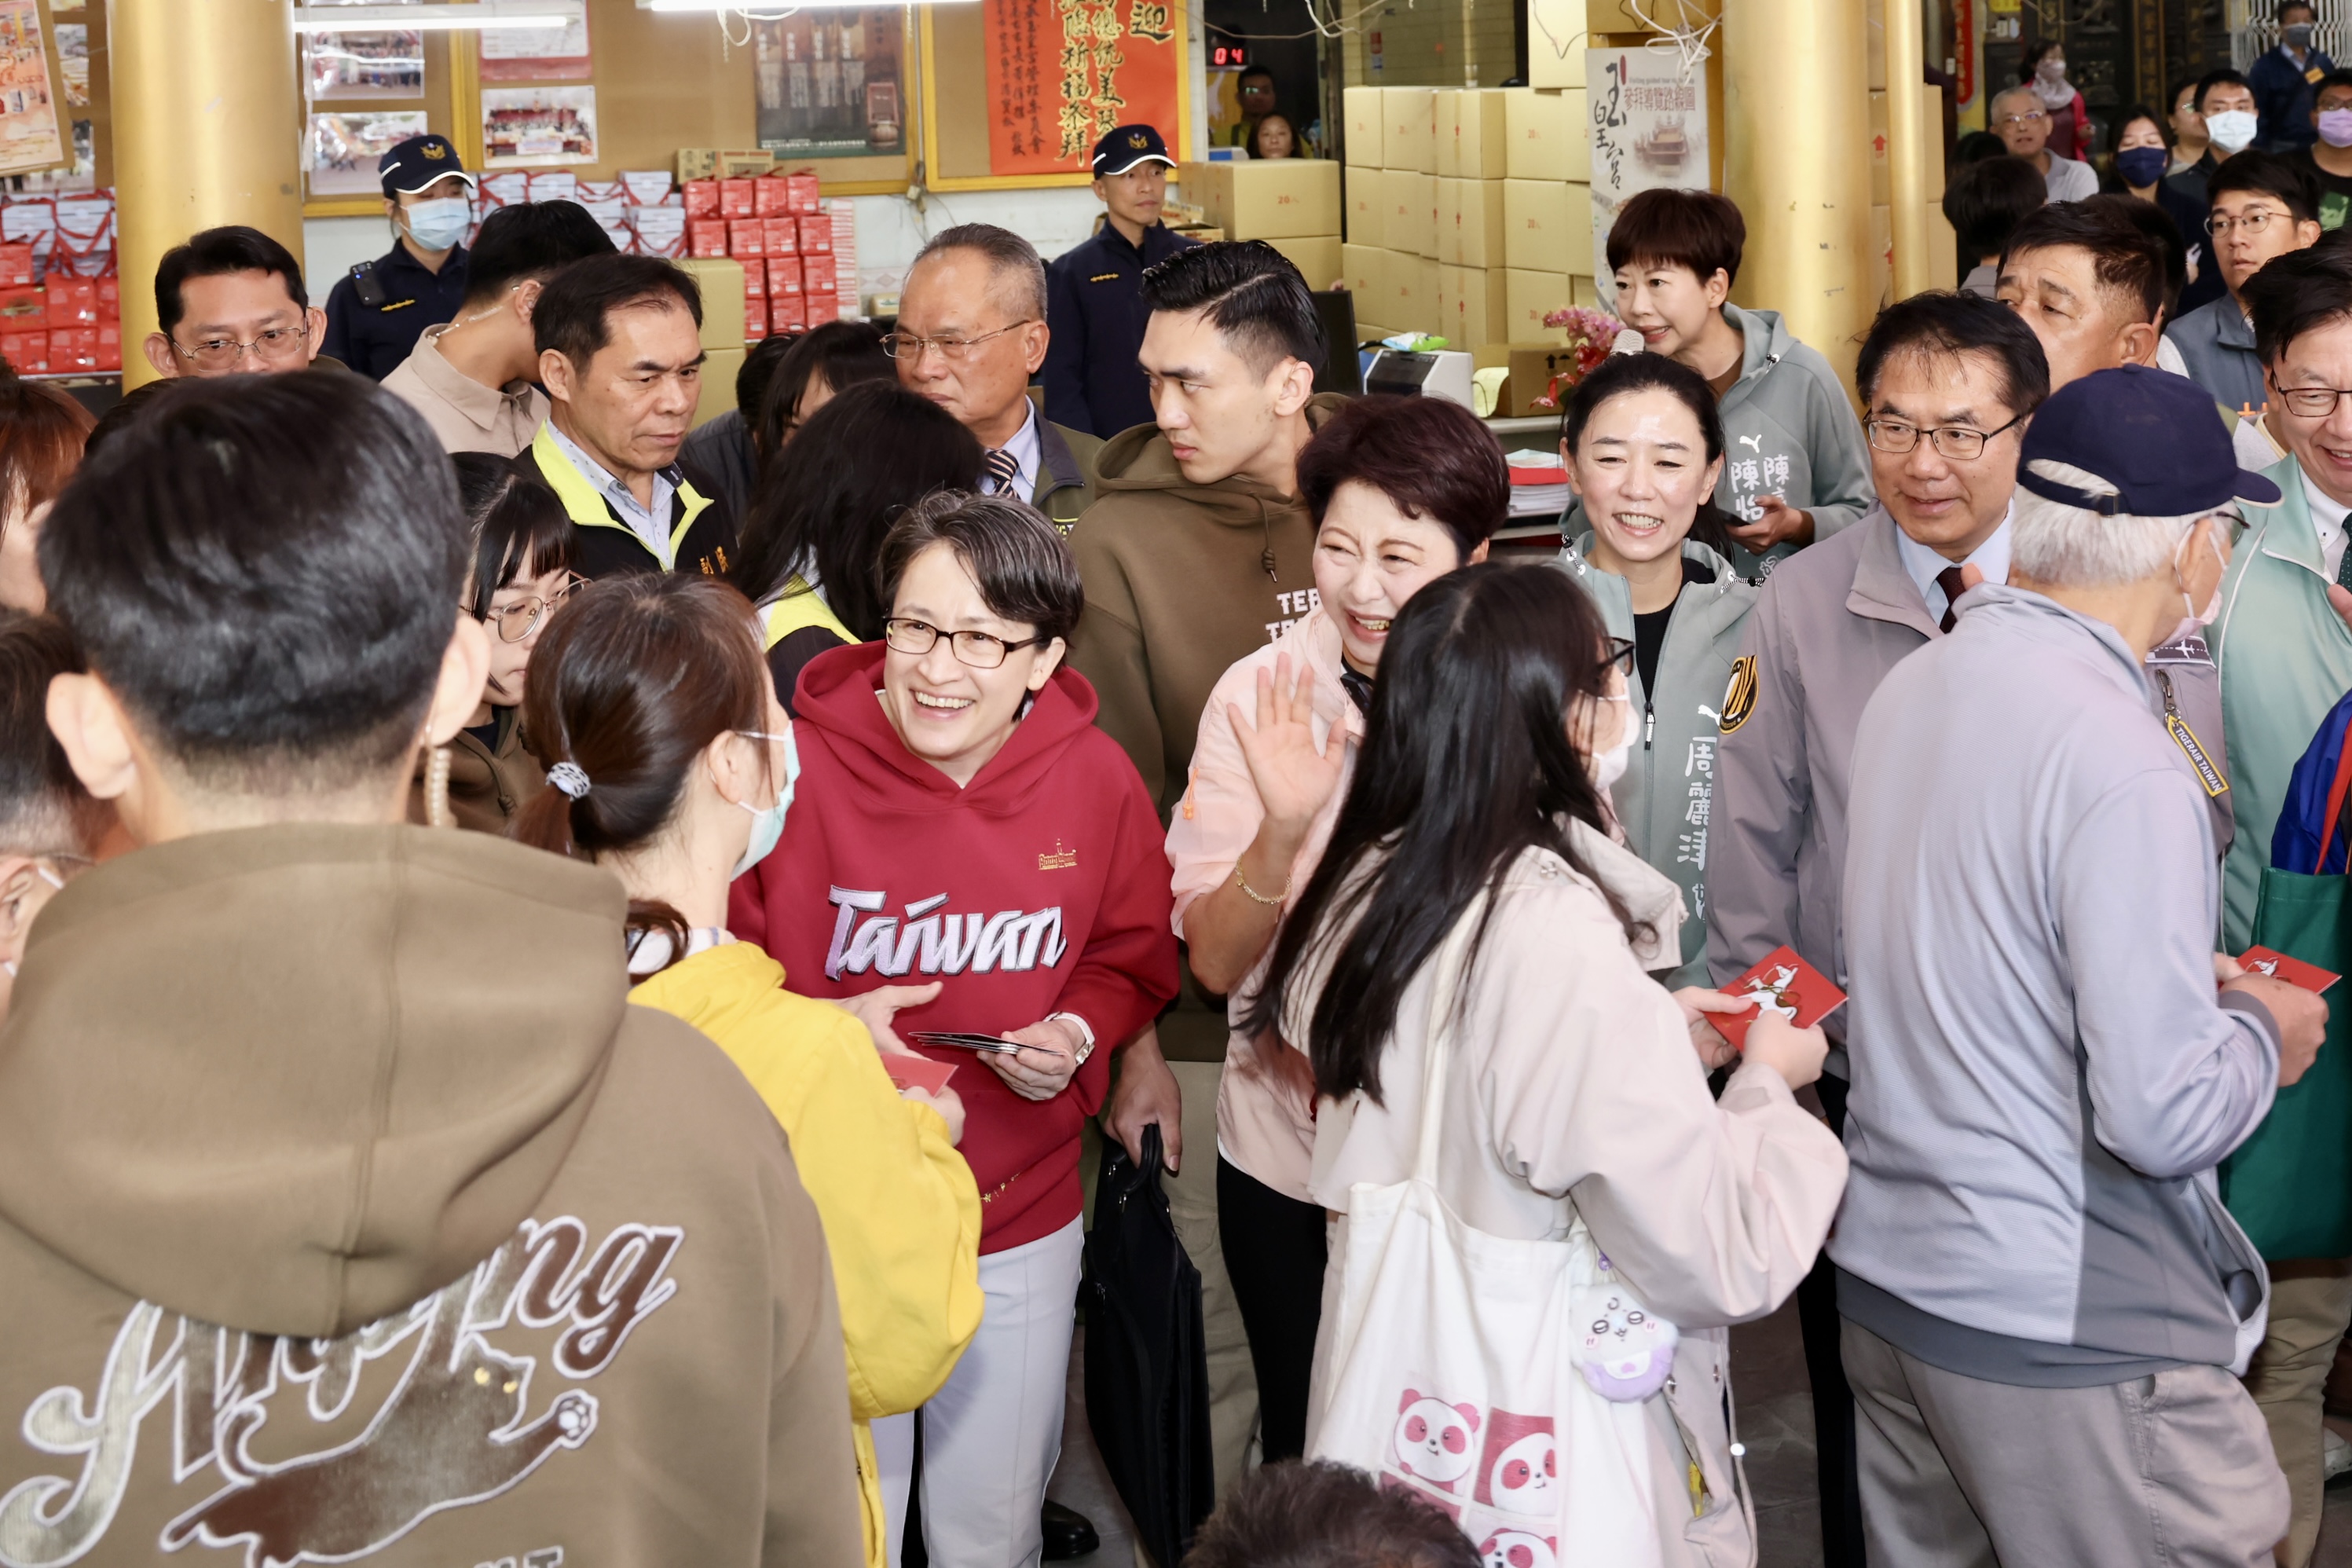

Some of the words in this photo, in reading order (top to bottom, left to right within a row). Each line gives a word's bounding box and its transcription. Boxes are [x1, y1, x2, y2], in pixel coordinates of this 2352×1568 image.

[1129, 2, 1174, 45] 迎
[1214, 48, 1243, 64] 04
[1091, 0, 1126, 140] 總統美琴
[2175, 727, 2203, 762] TIGERAIR
[2198, 760, 2222, 792] TAIWAN
[825, 885, 1066, 982] Taiwan
